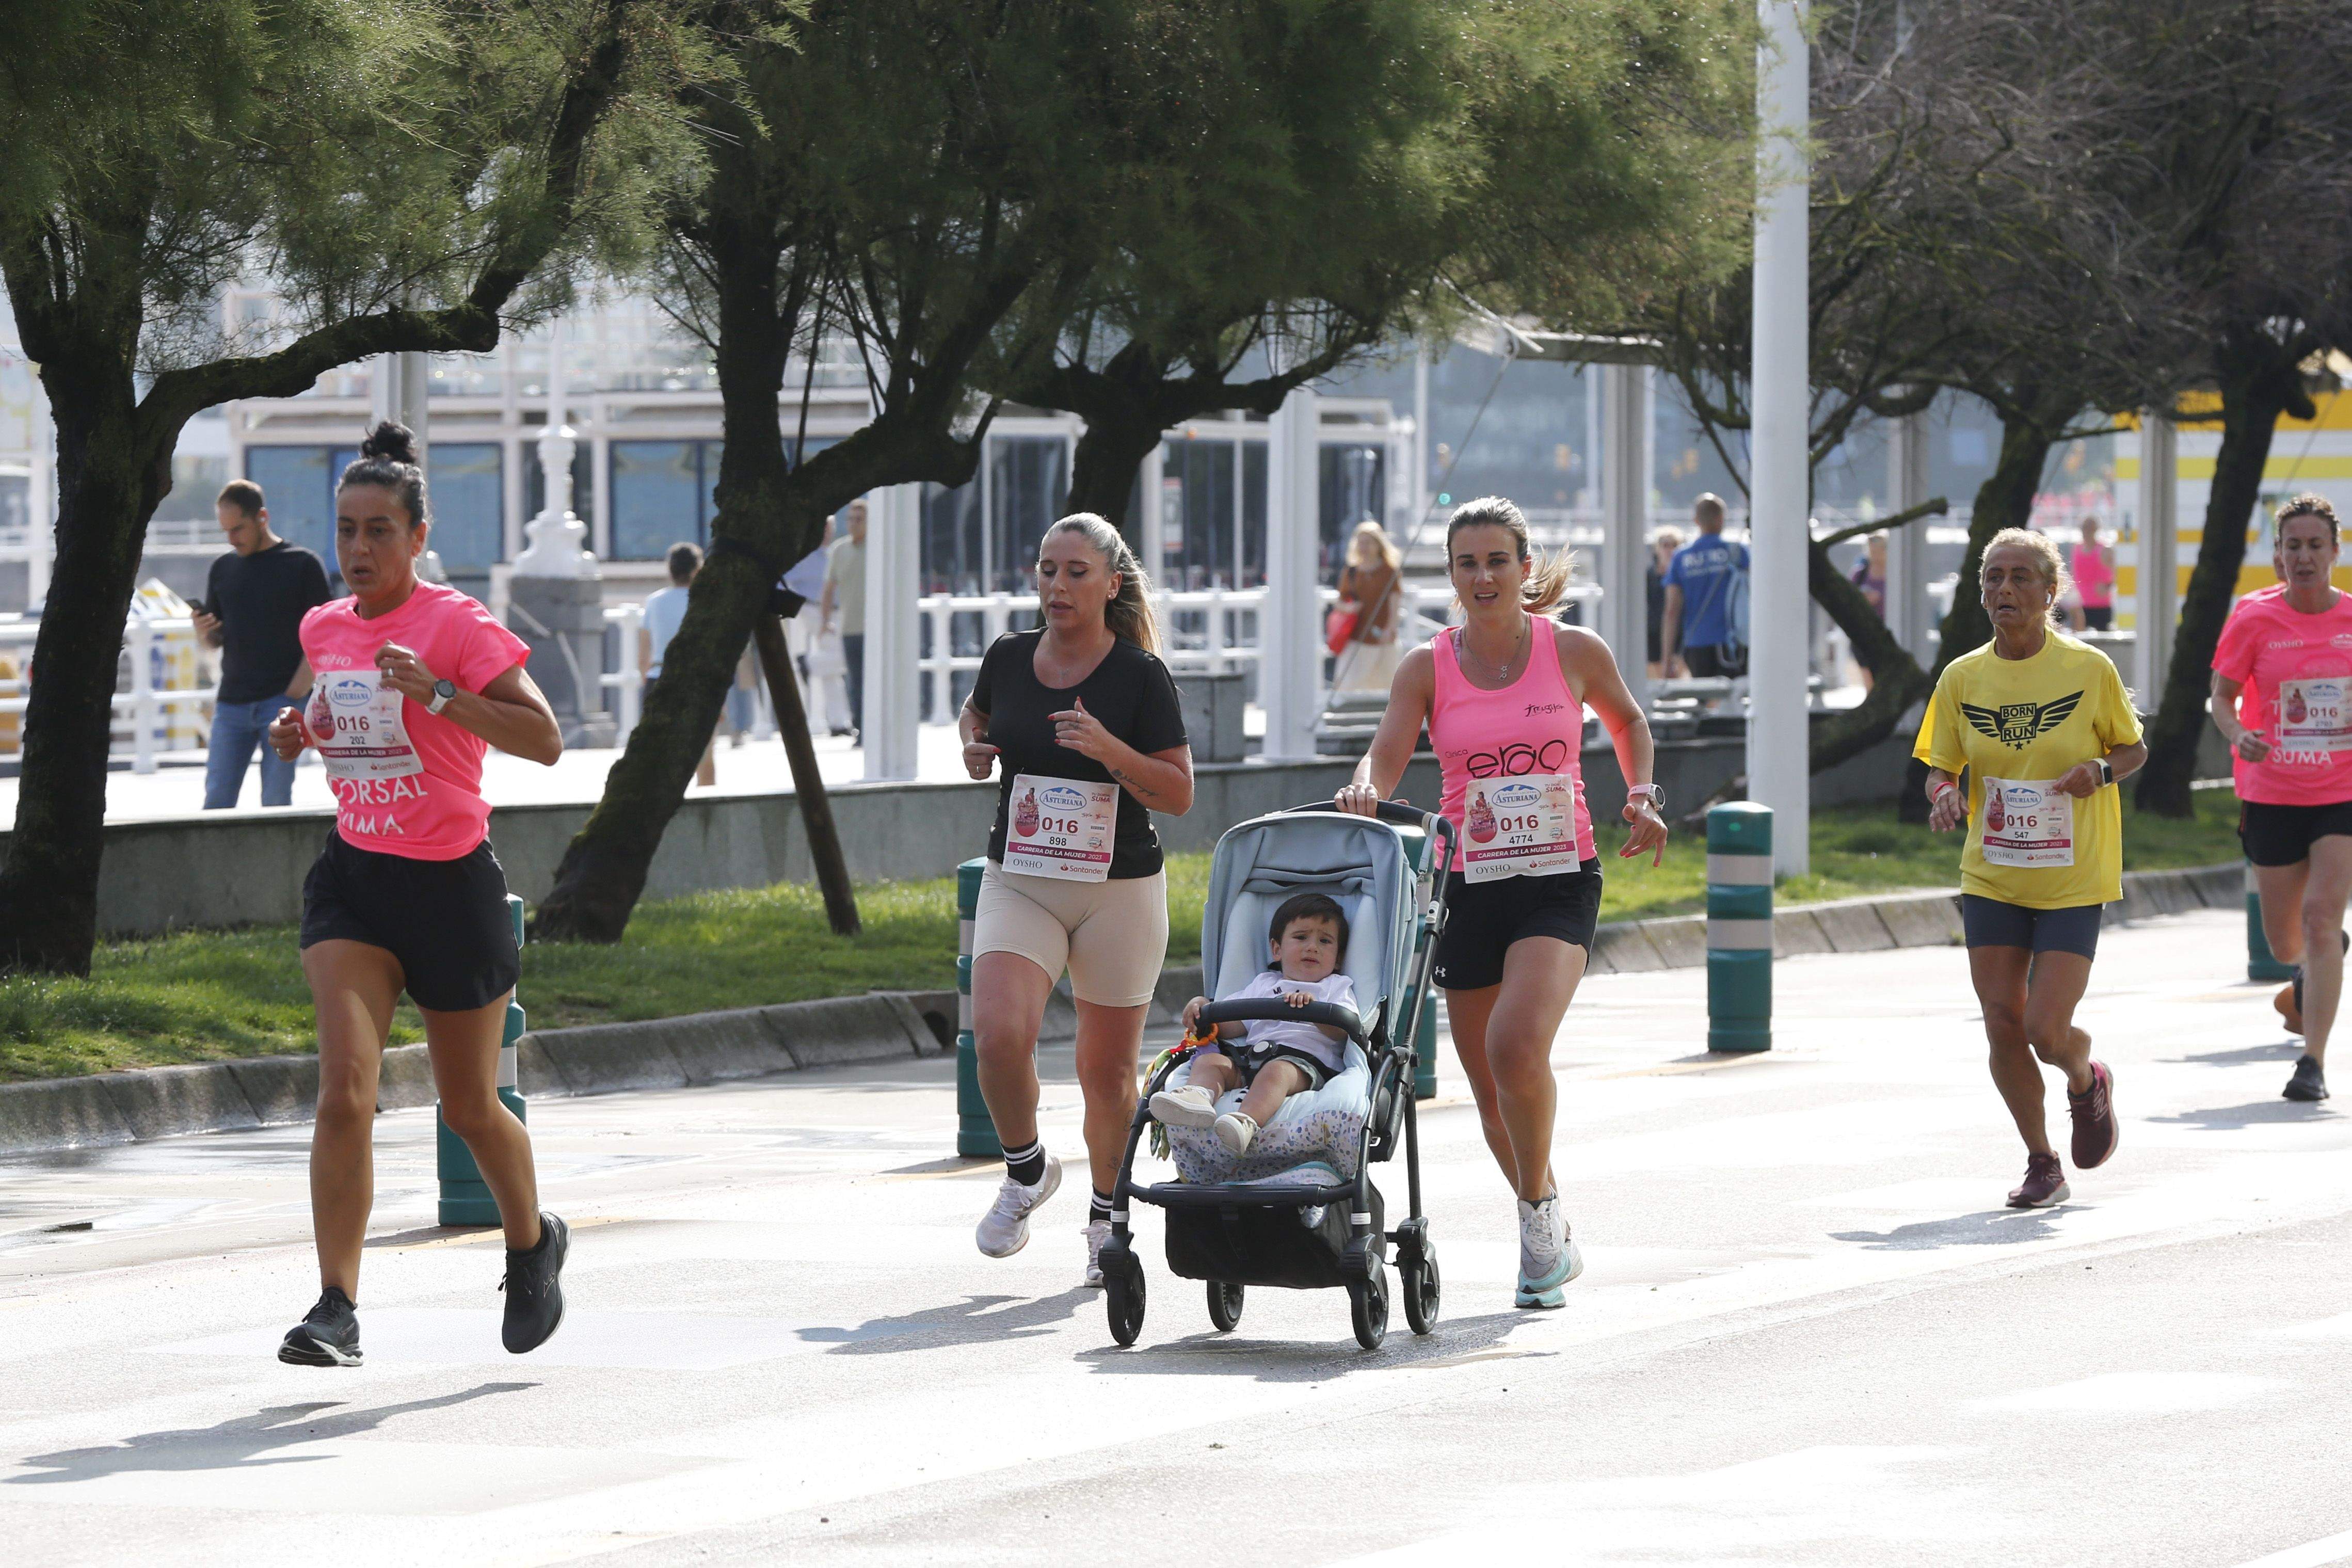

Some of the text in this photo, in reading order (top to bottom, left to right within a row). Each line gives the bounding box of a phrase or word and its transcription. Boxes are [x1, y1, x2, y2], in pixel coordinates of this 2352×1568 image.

[2003, 706, 2034, 718] BORN
[2310, 706, 2338, 717] 016
[337, 715, 370, 731] 016
[2003, 726, 2034, 739] RUN
[350, 736, 366, 745] 202
[2272, 746, 2332, 764] SUMA
[1043, 793, 1083, 806] ASTURIANA
[1496, 794, 1538, 804] ASTURIANA
[1042, 817, 1079, 834] 016
[1500, 814, 1539, 831] 016
[2007, 814, 2038, 827] 016
[1049, 836, 1067, 846] 898
[1509, 834, 1533, 844] 4774
[1017, 845, 1044, 854] CARRERA
[1477, 850, 1509, 859] CARRERA
[1988, 850, 2014, 859] OYSHO
[1013, 858, 1043, 869] OYSHO
[1476, 863, 1511, 874] OYSHO
[1538, 858, 1571, 868] Santander
[1069, 865, 1103, 875] Santander
